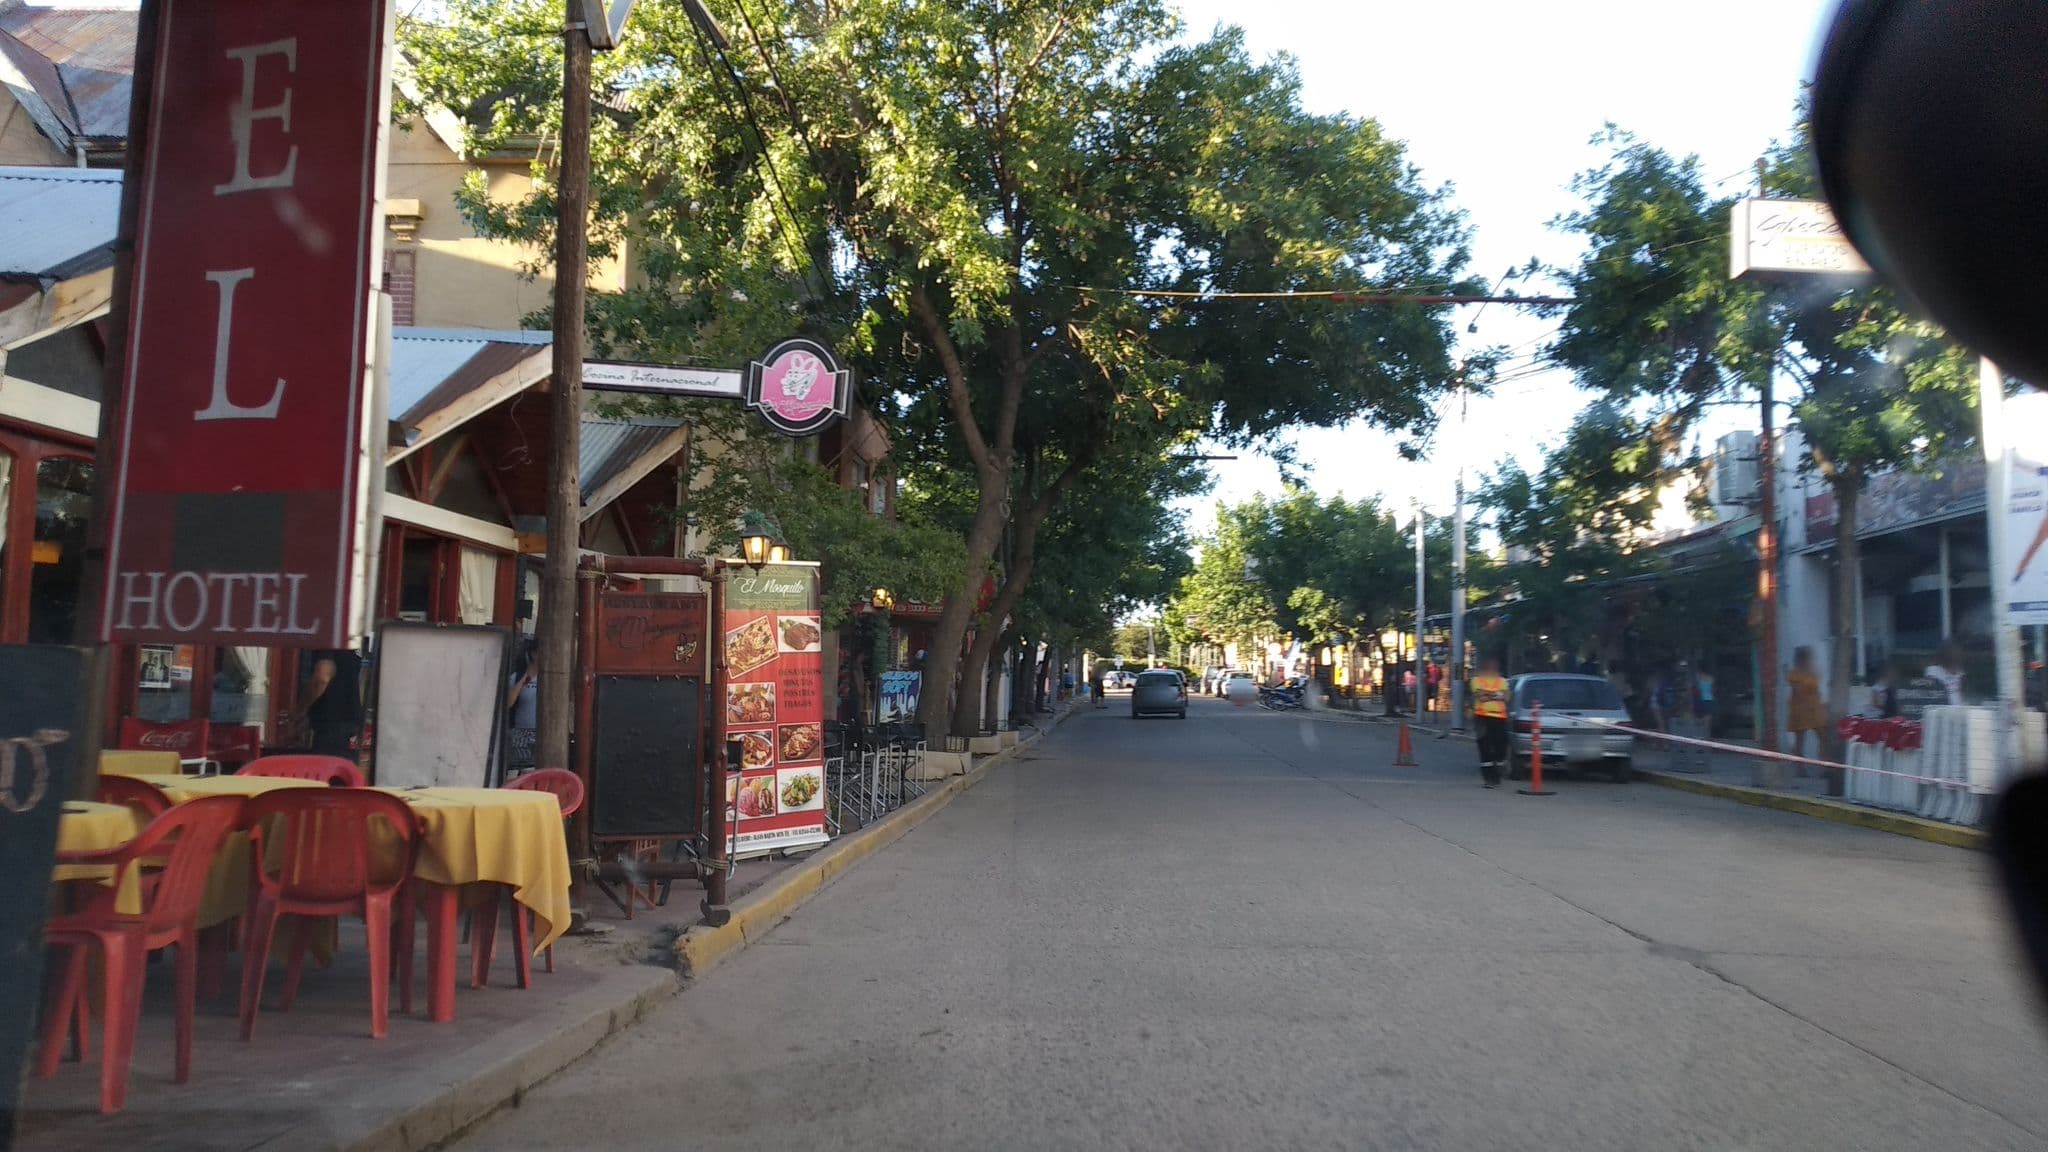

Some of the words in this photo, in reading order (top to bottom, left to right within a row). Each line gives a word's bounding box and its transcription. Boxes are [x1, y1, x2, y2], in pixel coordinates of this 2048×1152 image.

[115, 571, 319, 637] HOTEL
[734, 577, 754, 593] El
[755, 578, 804, 597] Mosquito
